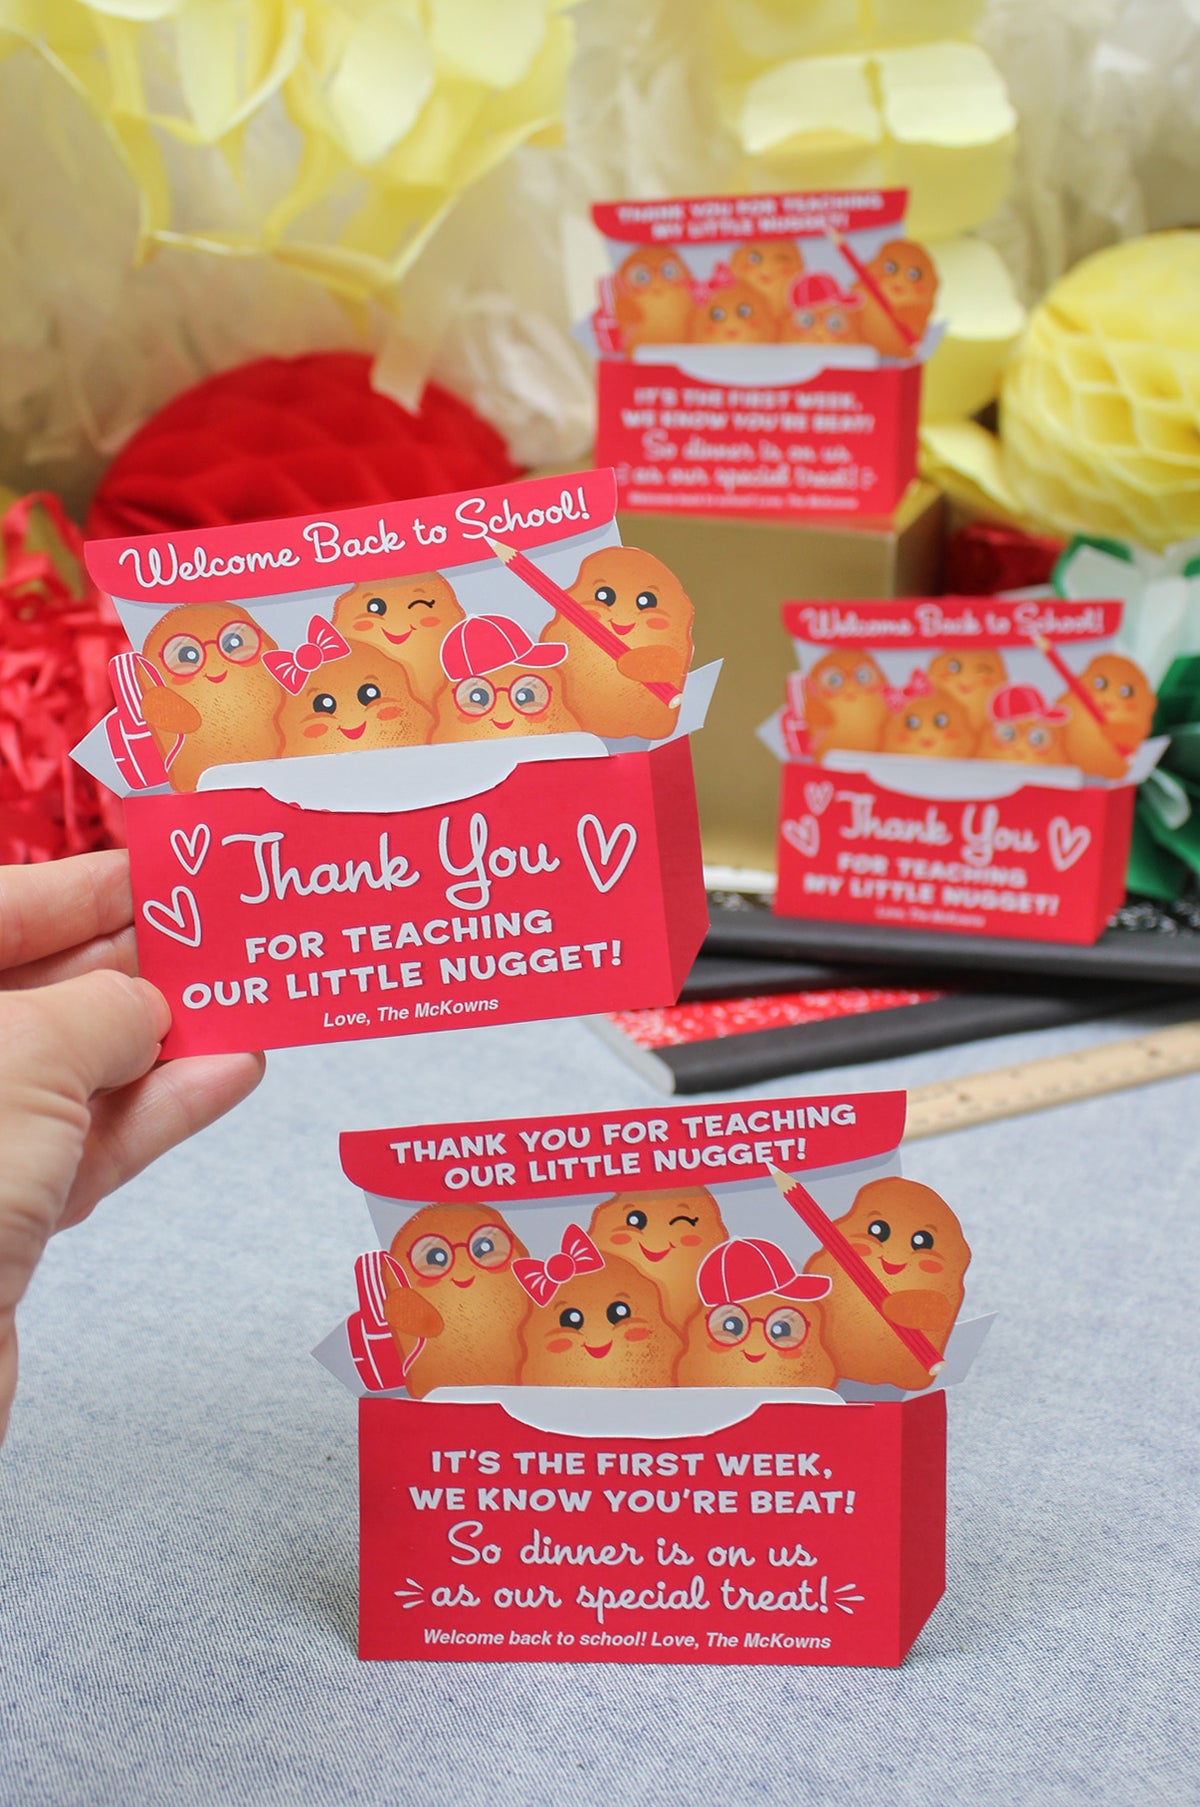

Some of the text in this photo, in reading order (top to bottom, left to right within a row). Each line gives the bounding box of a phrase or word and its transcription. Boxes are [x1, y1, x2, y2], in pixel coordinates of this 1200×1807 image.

[634, 387, 862, 411] IT'S THE FIRST WEEK,
[621, 409, 875, 433] WE KNOW YOU'RE BEAT!
[642, 428, 853, 462] So dinner is on us
[632, 464, 858, 494] as our special treat!
[119, 487, 591, 588] Welcome Back to School!
[799, 602, 1104, 638] Welcome Back to School!
[835, 790, 1039, 866] Thank You
[222, 812, 560, 910] Thank You
[838, 852, 1027, 888] FOR TEACHING
[804, 873, 843, 895] MY
[851, 877, 934, 903] LITTLE
[941, 885, 1060, 916] NUGGET!
[245, 909, 552, 964] FOR TEACHING
[182, 939, 623, 1010] OUR LITTLE NUGGET!
[323, 996, 500, 1027] Love, The McKowns
[391, 1103, 857, 1165] THANK YOU FOR TEACHING
[444, 1137, 807, 1191] OUR LITTLE NUGGET!
[431, 1450, 833, 1480] IT'S THE FIRST WEEK,
[409, 1486, 856, 1515] WE KNOW YOU'RE BEAT!
[447, 1520, 818, 1568] So dinner is on us
[431, 1575, 830, 1624] as our special treat!
[423, 1628, 832, 1650] Welcome back to school! Love, The McKowns
